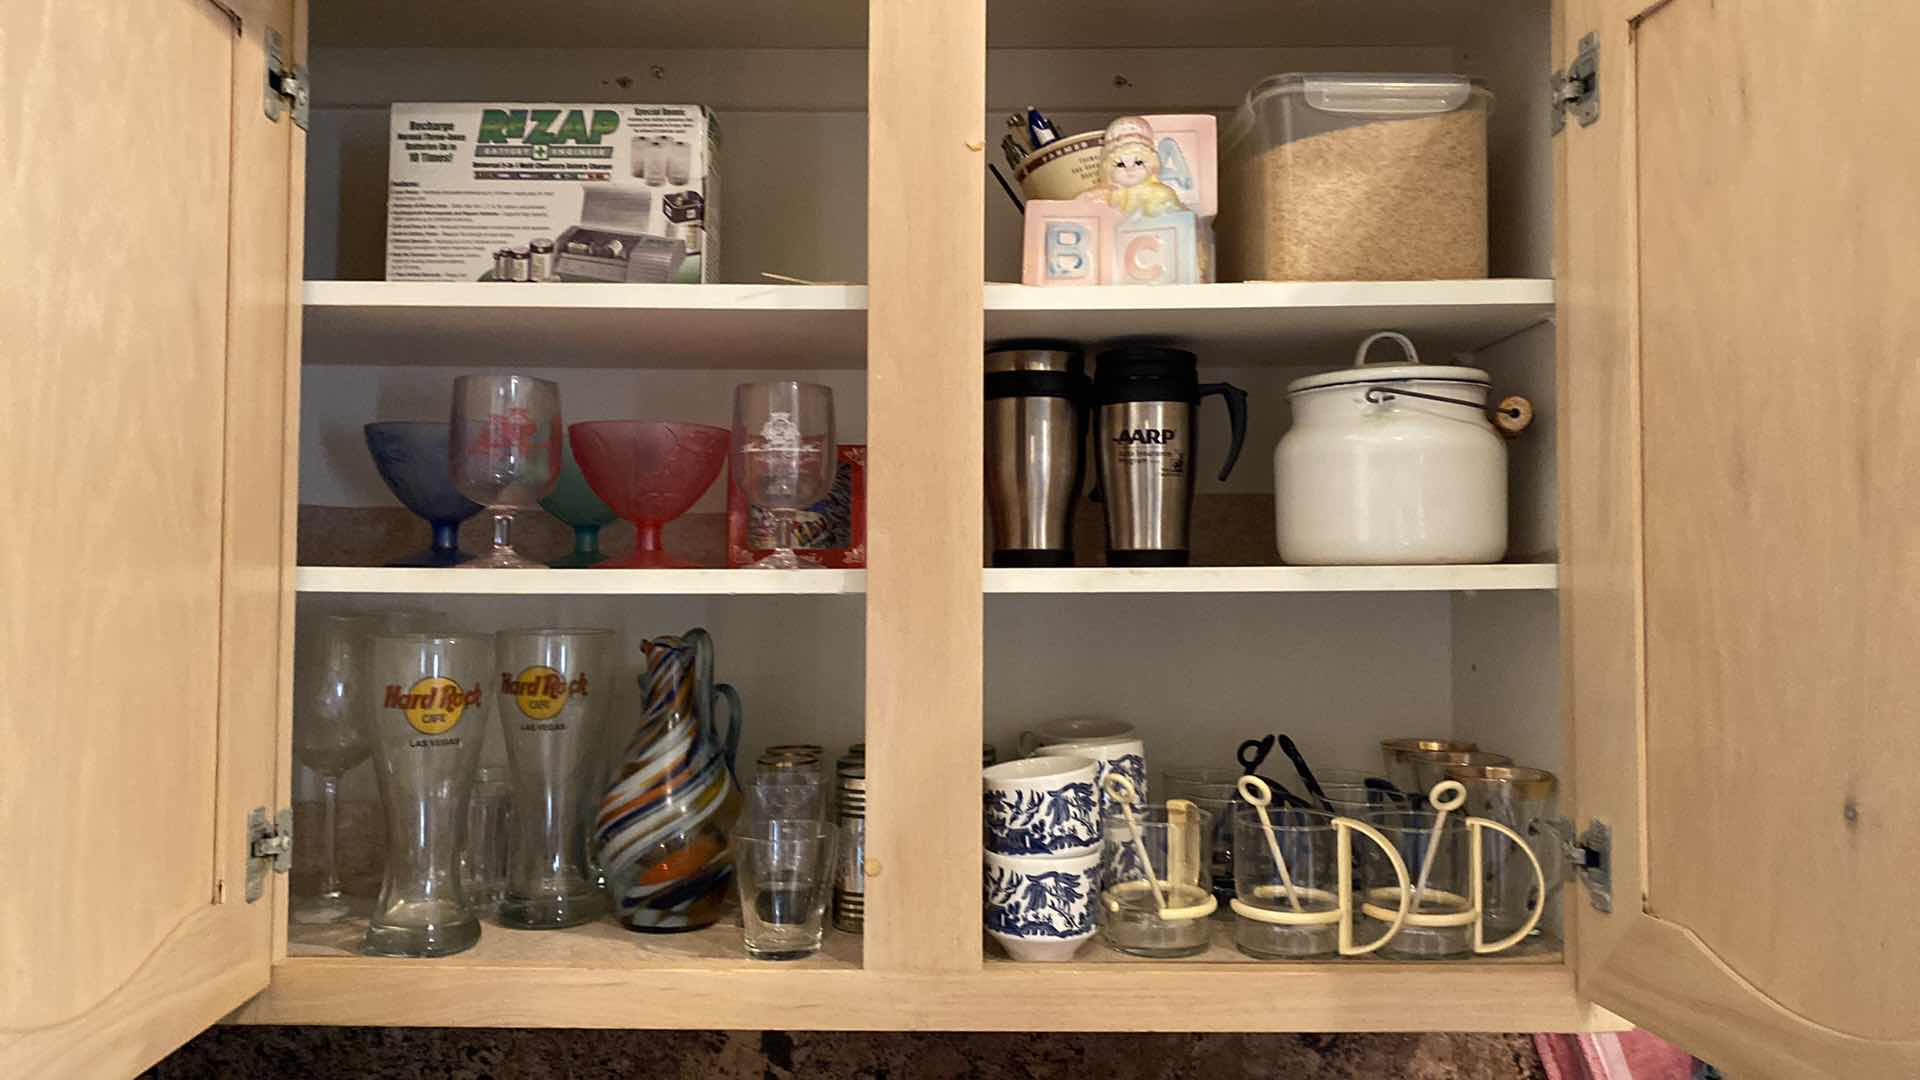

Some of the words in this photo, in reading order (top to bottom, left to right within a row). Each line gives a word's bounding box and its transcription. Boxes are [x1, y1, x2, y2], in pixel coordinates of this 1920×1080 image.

[410, 121, 454, 132] Recharge
[478, 109, 620, 144] RIZAP
[1157, 137, 1193, 191] A
[1046, 222, 1089, 280] B
[1124, 235, 1166, 281] C
[1112, 429, 1175, 444] AARP
[384, 684, 437, 709] Hard
[437, 682, 481, 712] Rock
[501, 671, 542, 697] Hard
[541, 671, 588, 699] Rock
